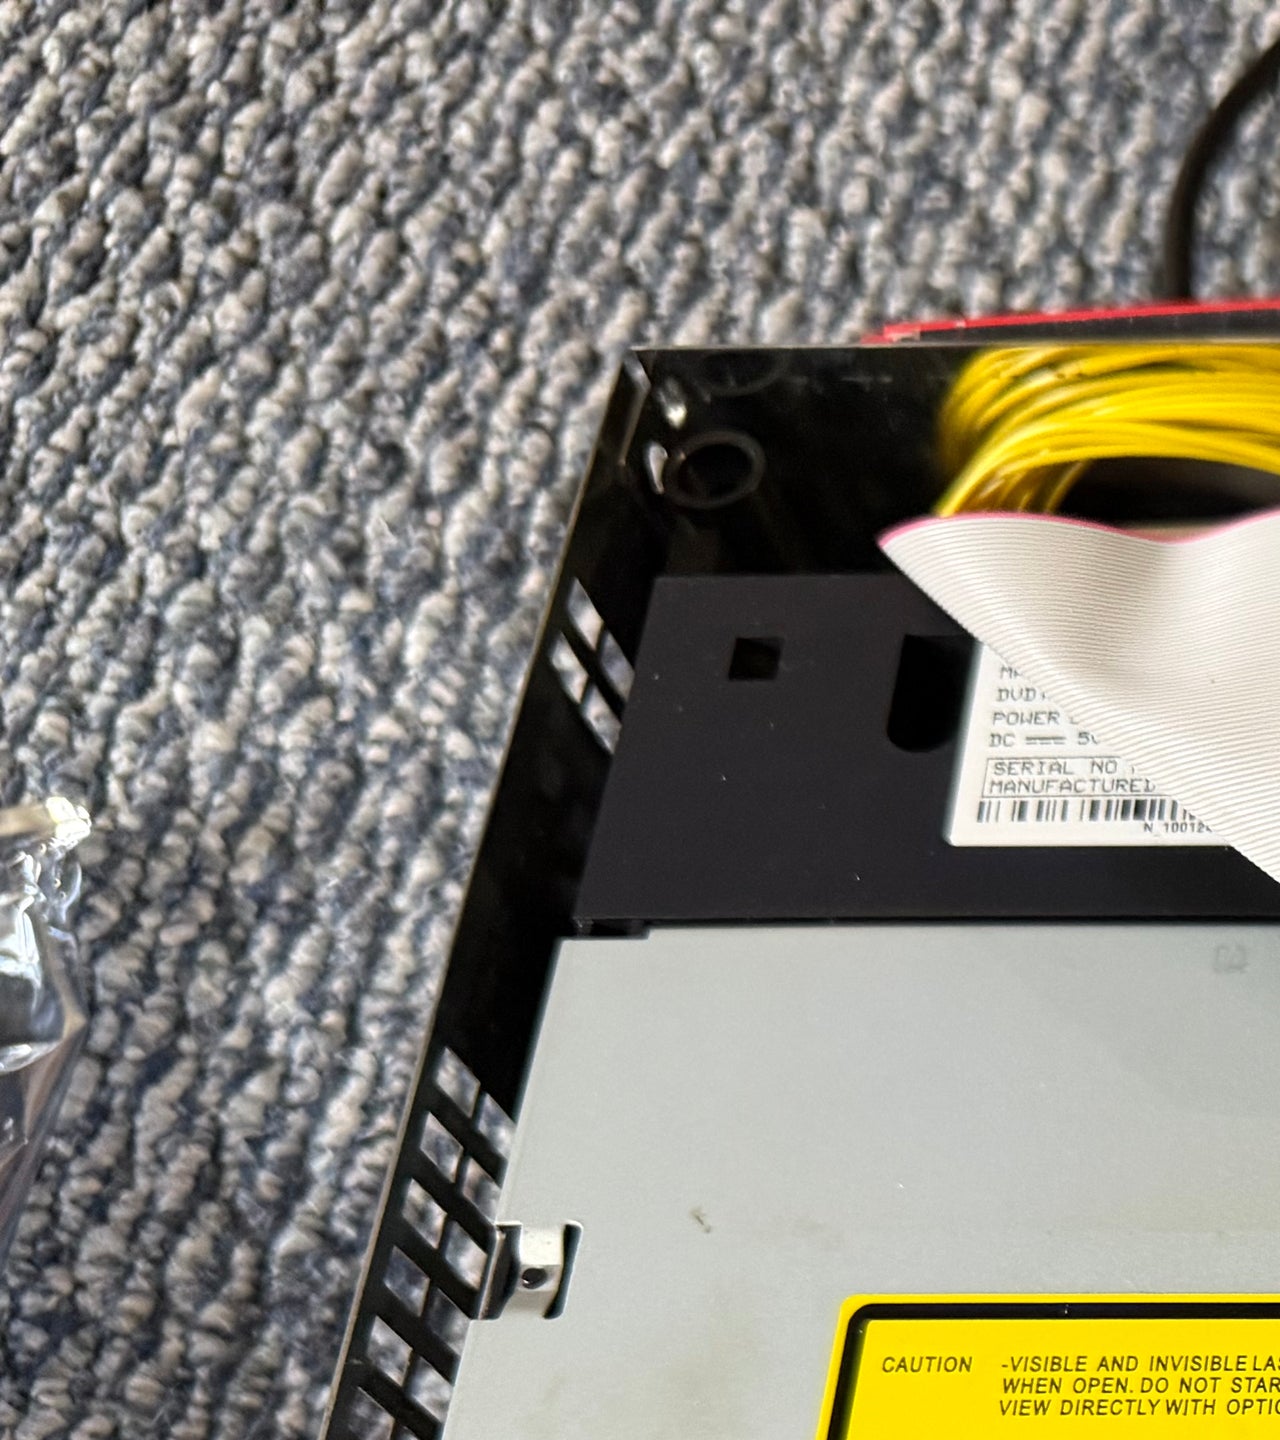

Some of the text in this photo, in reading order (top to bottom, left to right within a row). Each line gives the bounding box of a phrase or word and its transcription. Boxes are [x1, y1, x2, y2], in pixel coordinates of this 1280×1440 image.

[993, 710, 1060, 726] POWER
[989, 733, 1013, 748] DC
[993, 761, 1074, 776] SERIAL
[882, 1356, 972, 1373] CAUTION
[1002, 1356, 1087, 1372] -VISIBLE
[1097, 1356, 1138, 1371] AND
[1150, 1355, 1247, 1371] INVISIBLE
[1004, 1378, 1061, 1394] WHEN
[1073, 1377, 1134, 1393] OPEN.
[1141, 1377, 1168, 1393] DO
[1180, 1377, 1221, 1393] NOT
[1000, 1400, 1051, 1416] VIEW
[1060, 1399, 1160, 1415] DIRECTLY
[1166, 1399, 1215, 1416] WITH
